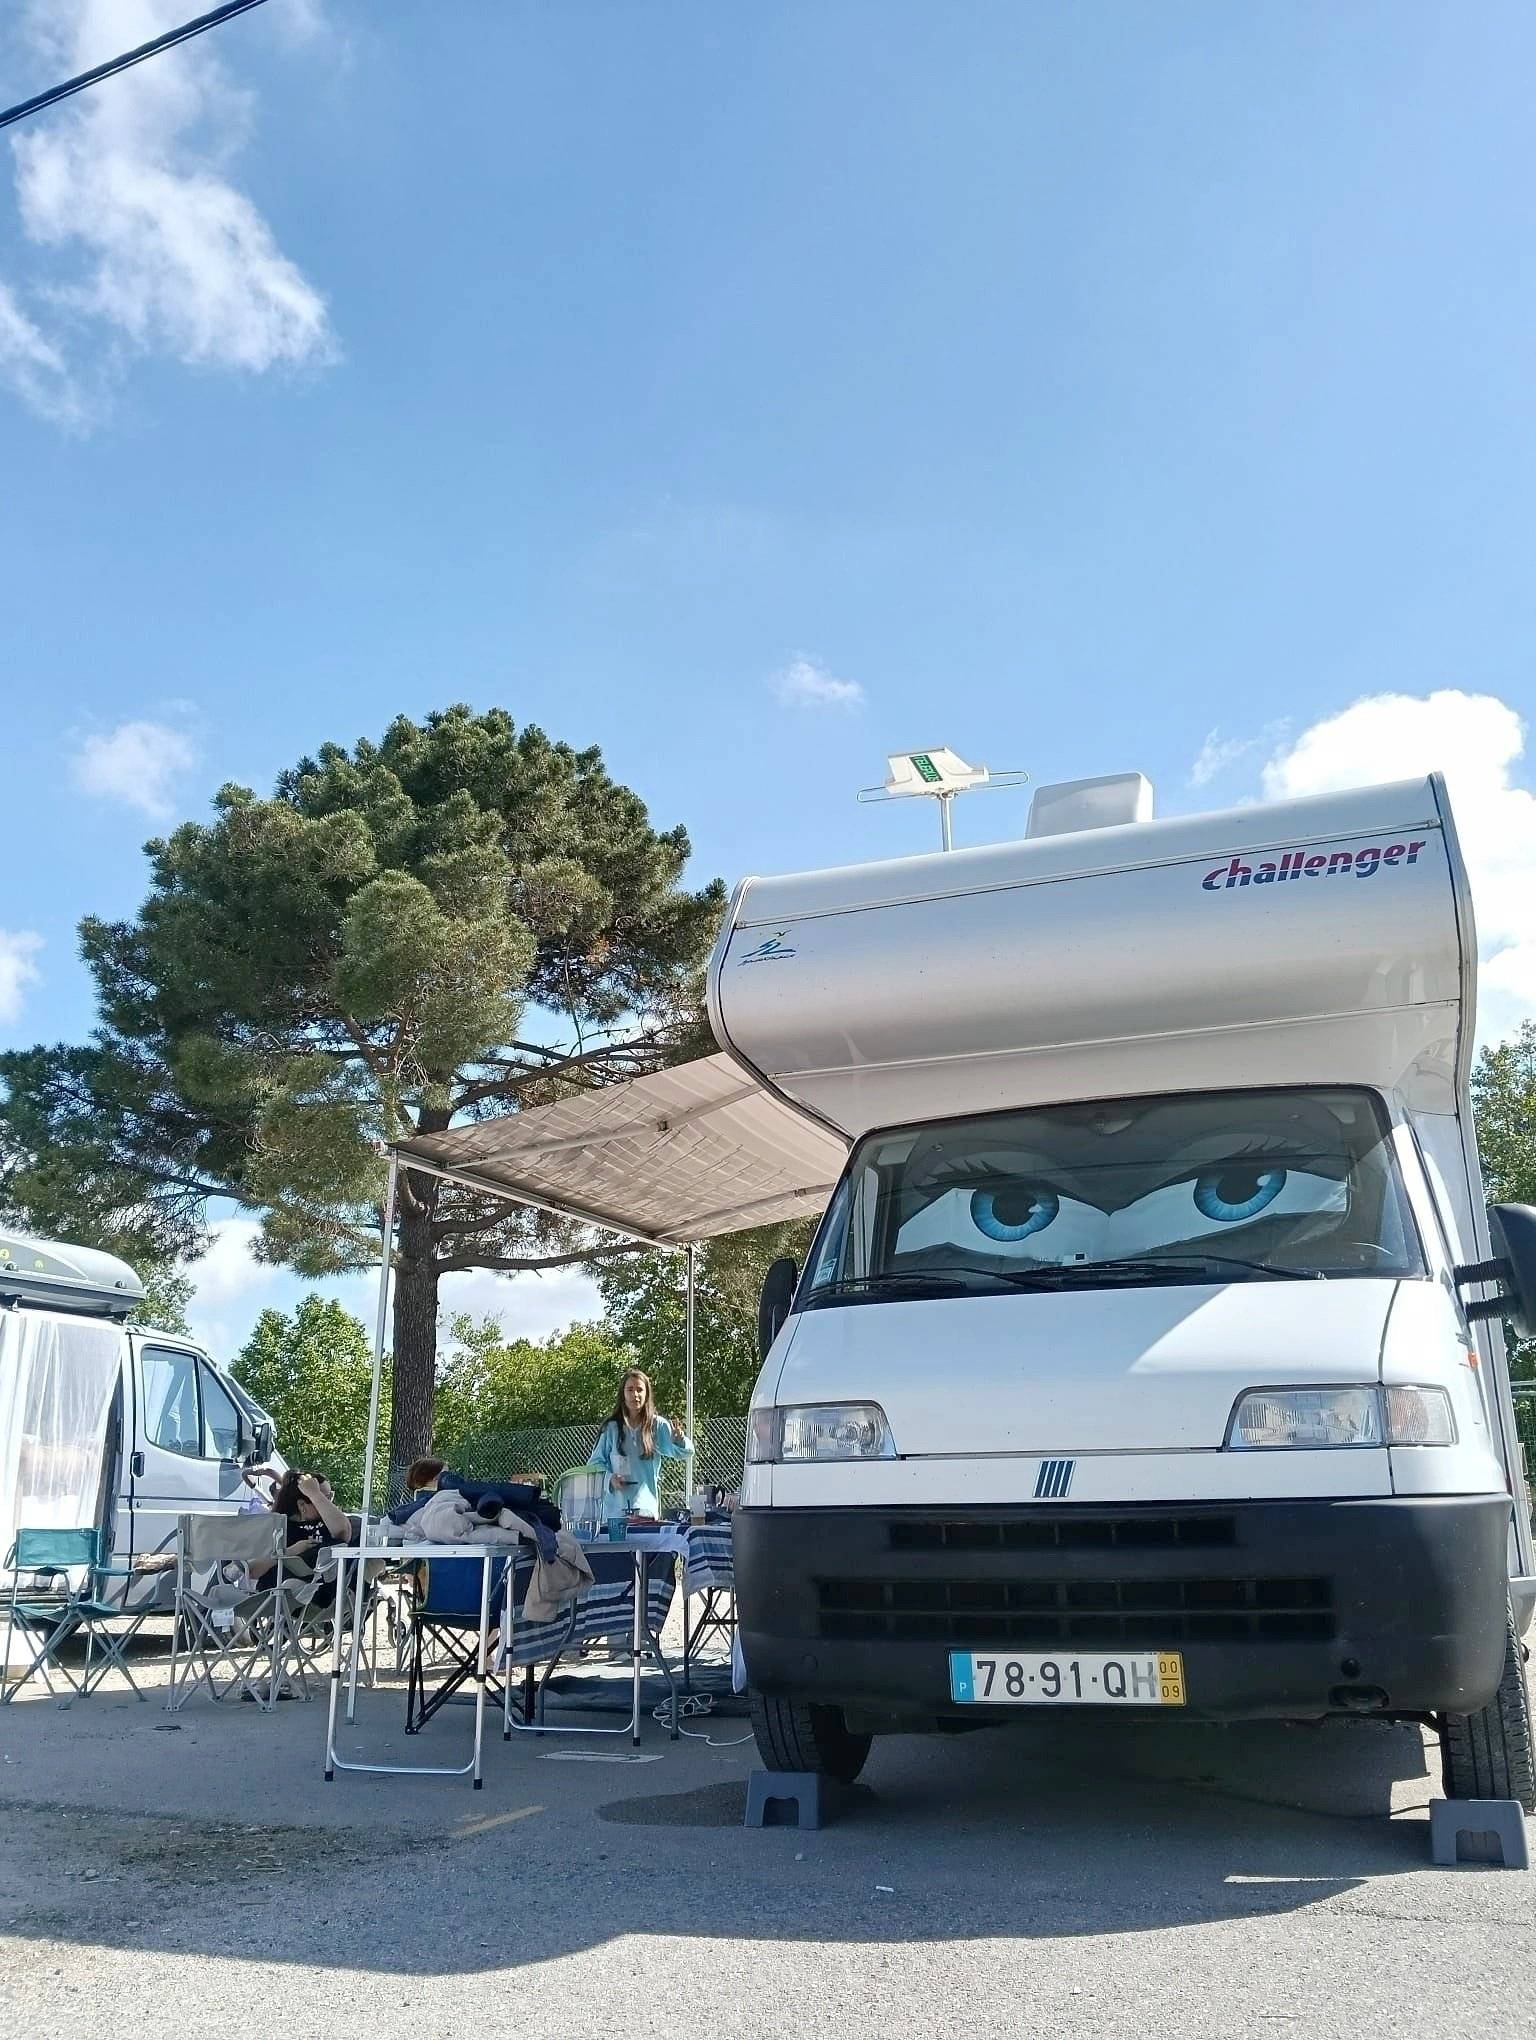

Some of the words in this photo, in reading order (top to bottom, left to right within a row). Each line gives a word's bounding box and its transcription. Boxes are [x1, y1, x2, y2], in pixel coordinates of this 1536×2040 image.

[1159, 1660, 1178, 1674] 00
[959, 1683, 966, 1693] P
[1161, 1684, 1180, 1698] 09
